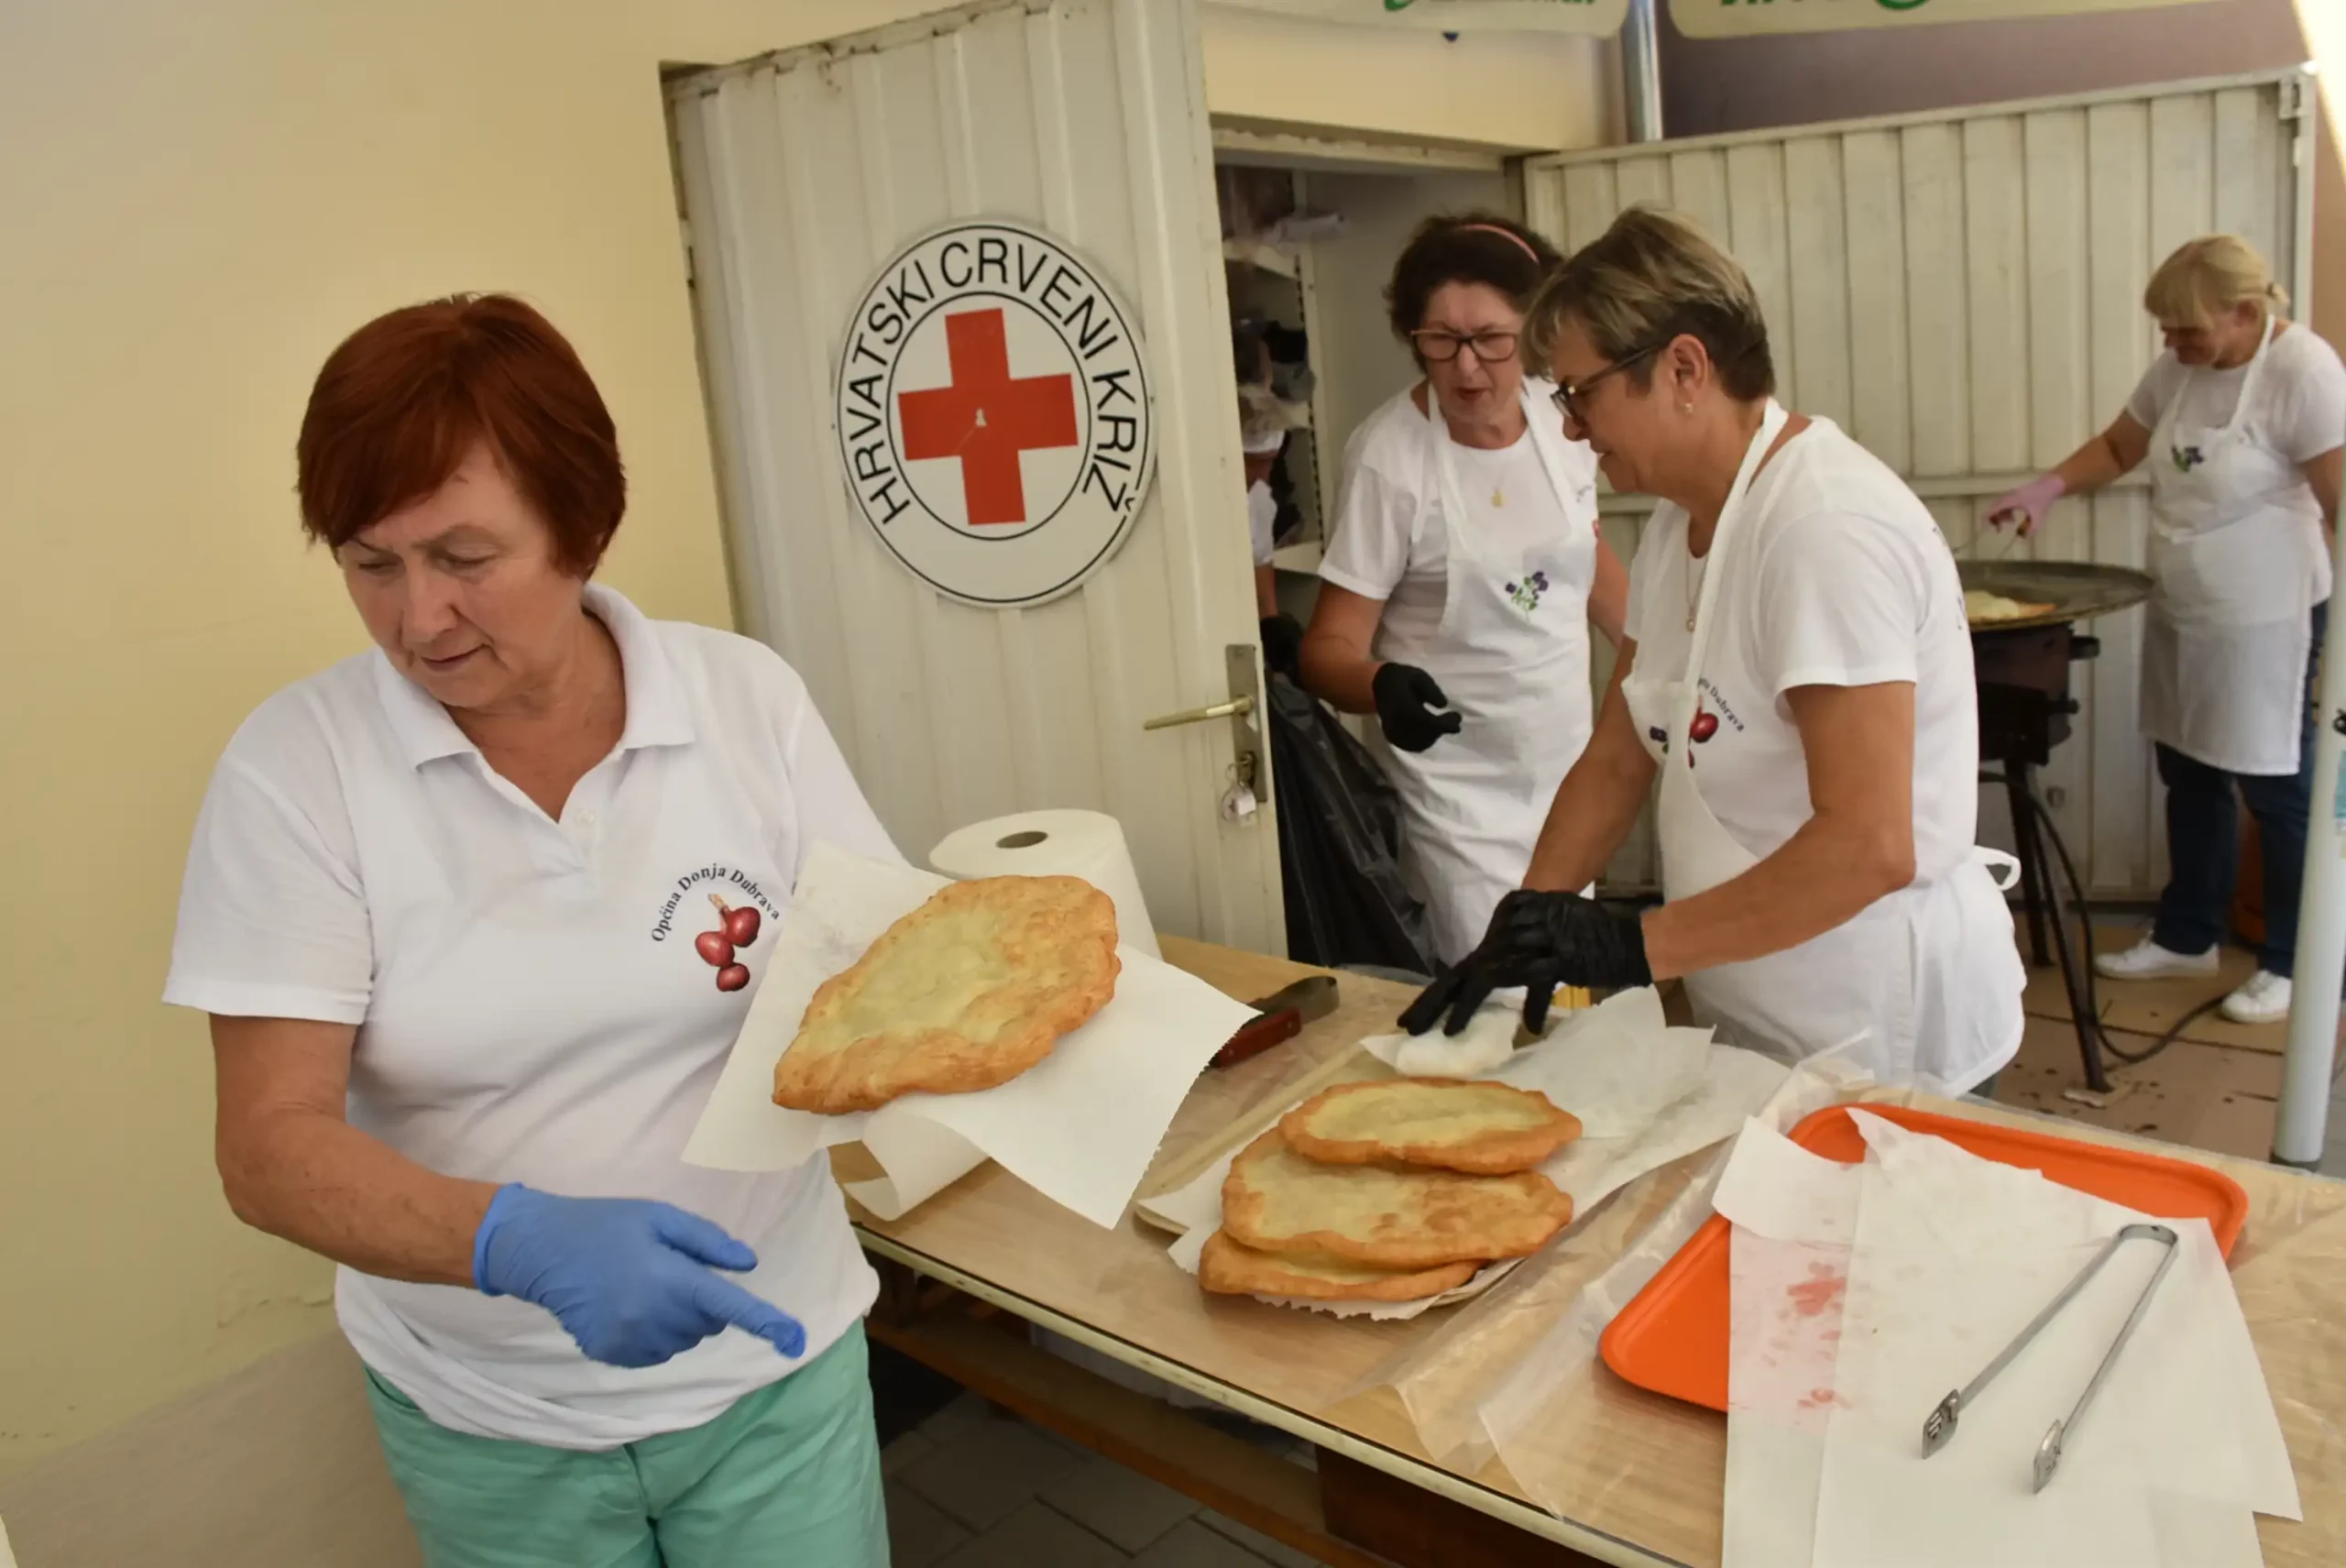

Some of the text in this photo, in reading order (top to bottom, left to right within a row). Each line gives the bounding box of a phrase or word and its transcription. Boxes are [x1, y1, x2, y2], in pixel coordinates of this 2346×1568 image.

[846, 237, 1136, 524] HRVATSKI CRVENI KRIŽ
[677, 862, 727, 892] Donja
[729, 869, 780, 920] Dubrava
